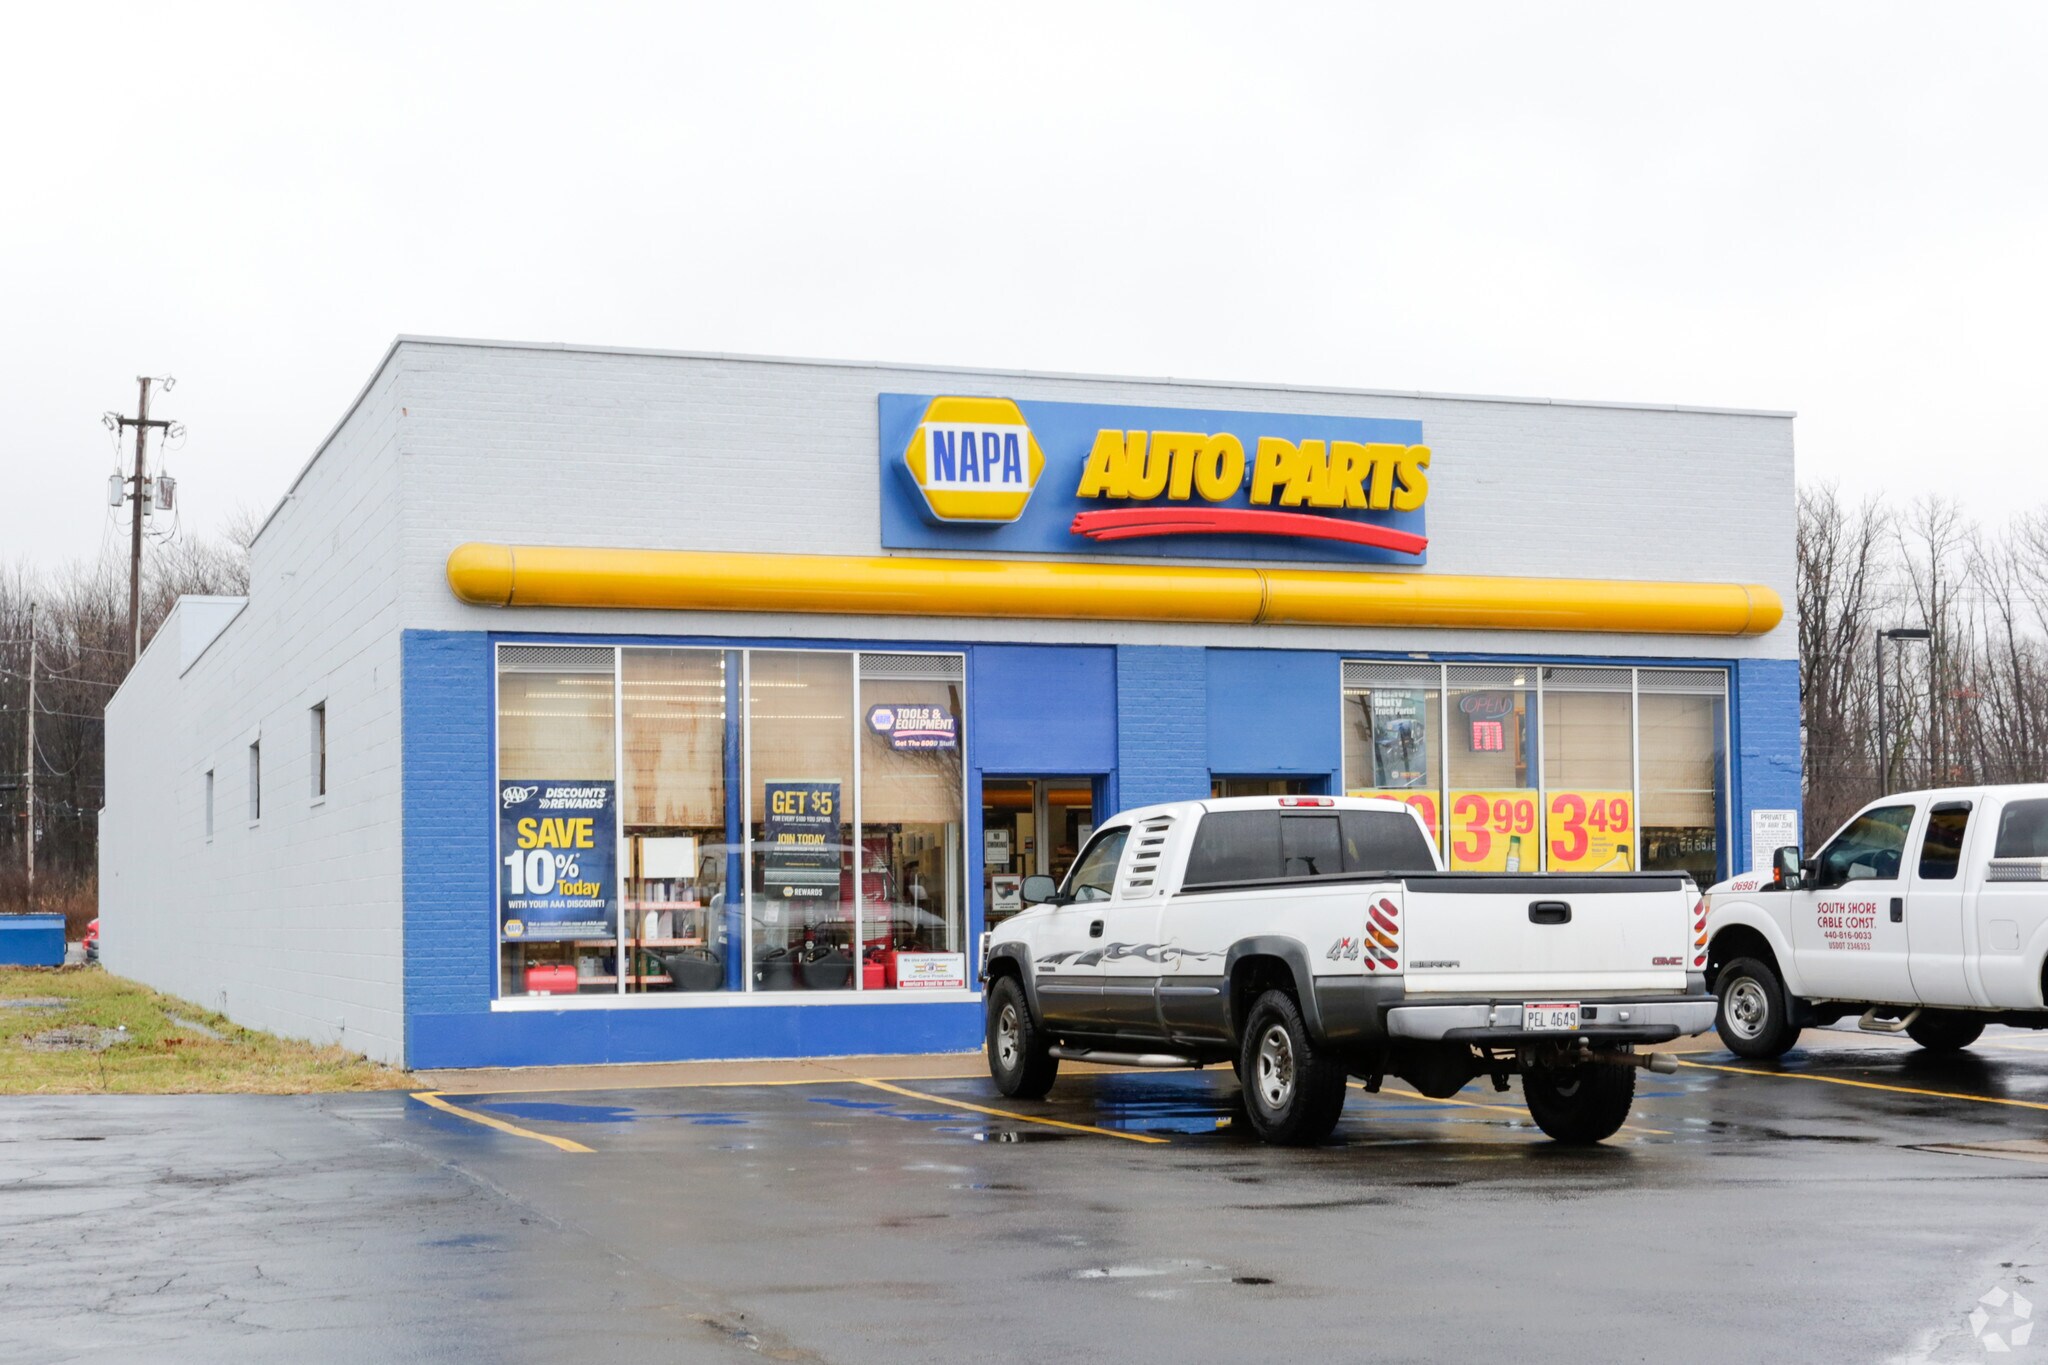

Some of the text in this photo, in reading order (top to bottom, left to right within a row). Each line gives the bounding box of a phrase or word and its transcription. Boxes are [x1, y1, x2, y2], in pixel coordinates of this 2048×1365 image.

[932, 430, 1023, 484] NAPA
[1076, 429, 1431, 512] AUTO PARTS
[1374, 698, 1403, 708] Duty
[1465, 698, 1507, 713] OPEN
[897, 708, 941, 719] TOOLS &
[1374, 707, 1394, 715] Truck
[895, 719, 954, 730] EQUIPMENT
[504, 787, 607, 803] AAA DISCOUNTS
[550, 799, 604, 809] REWARDS
[772, 790, 833, 815] GET $5
[517, 817, 594, 849] SAVE
[777, 833, 826, 845] JOIN TODAY
[556, 879, 601, 899] Today
[1731, 880, 1759, 891] 06981
[794, 888, 823, 896] REWARDS
[508, 899, 605, 909] WITH YOUR AAA DISCOUNT!
[1817, 902, 1876, 914] SOUTH SHORE
[1817, 916, 1877, 929] CABLE CONST.
[1824, 931, 1872, 940] 440-816-0033
[1828, 941, 1845, 950] USDOT
[1409, 960, 1460, 968] SIERRA
[1652, 956, 1683, 966] GMC
[1528, 1011, 1576, 1027] PEL 4649
